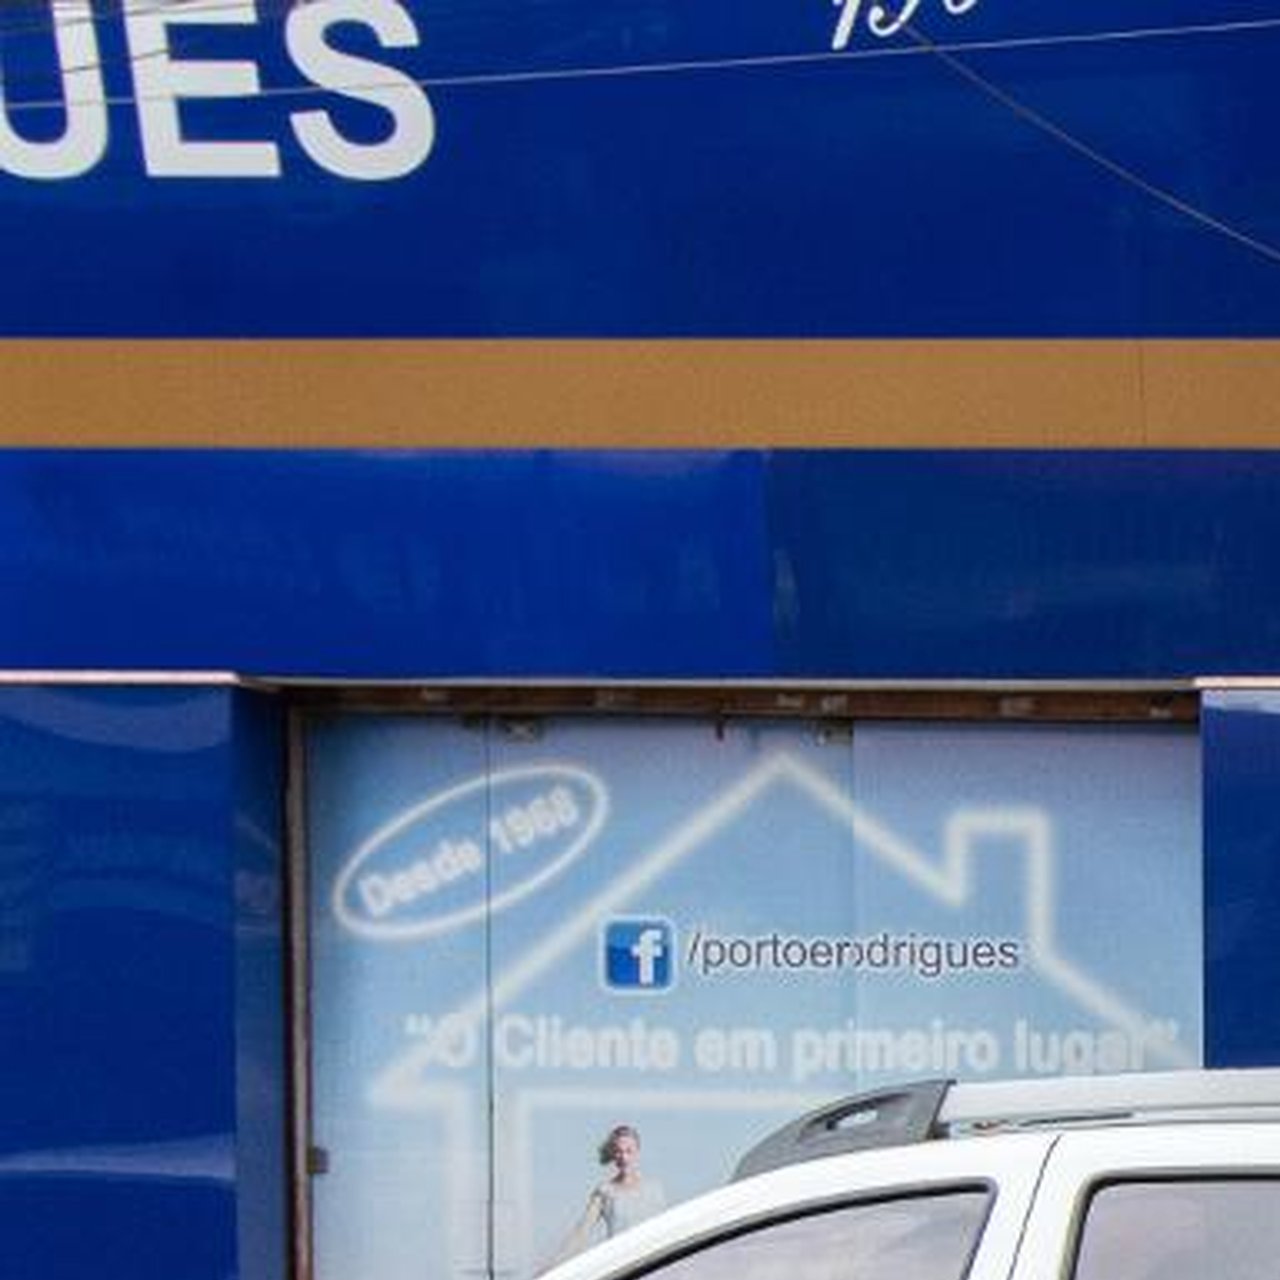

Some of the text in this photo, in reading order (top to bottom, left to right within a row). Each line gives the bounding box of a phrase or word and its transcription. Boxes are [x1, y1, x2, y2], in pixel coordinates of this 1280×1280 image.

[0, 0, 436, 181] UES
[358, 836, 483, 918] Desde
[499, 1011, 680, 1071] Cliente
[694, 1026, 778, 1071] em
[792, 1018, 999, 1083] primeiro
